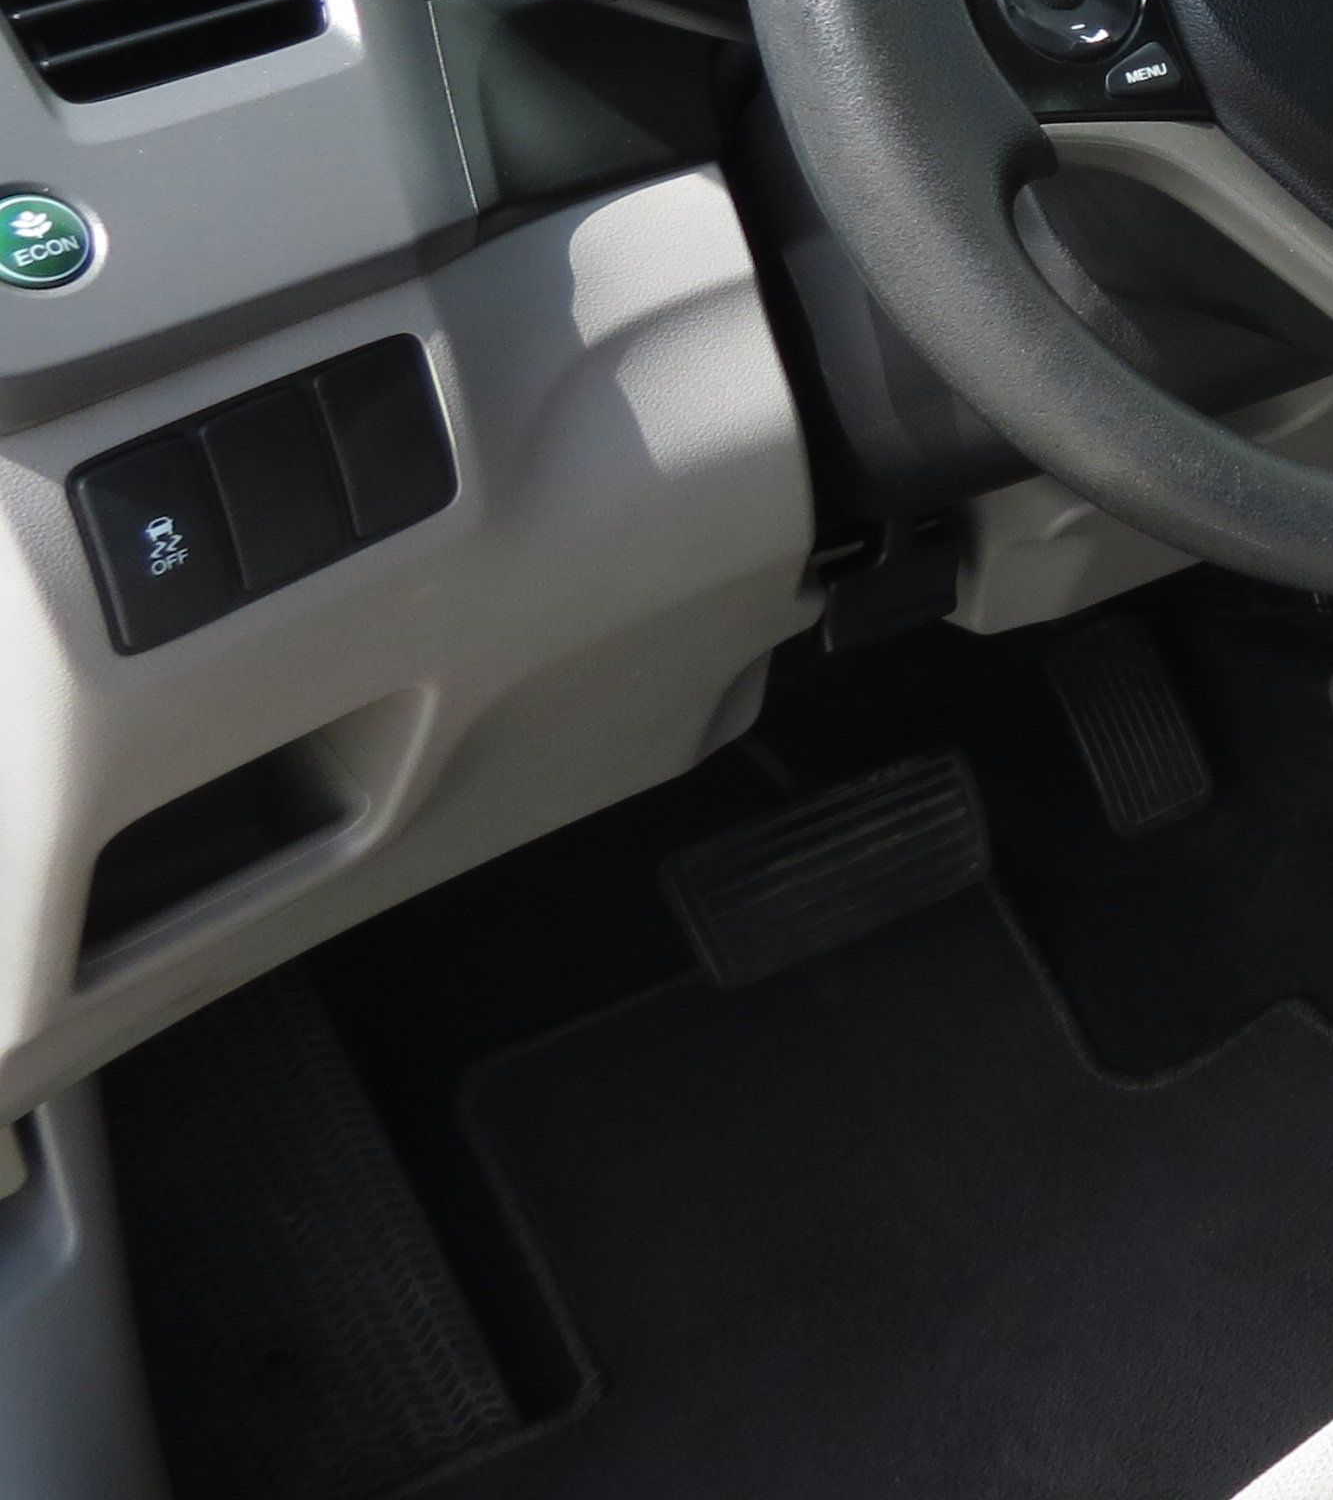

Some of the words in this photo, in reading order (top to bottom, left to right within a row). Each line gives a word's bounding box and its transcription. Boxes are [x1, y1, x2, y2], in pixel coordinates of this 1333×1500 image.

[1125, 63, 1167, 84] MENU
[14, 236, 80, 268] ECON
[151, 549, 189, 577] OFF
